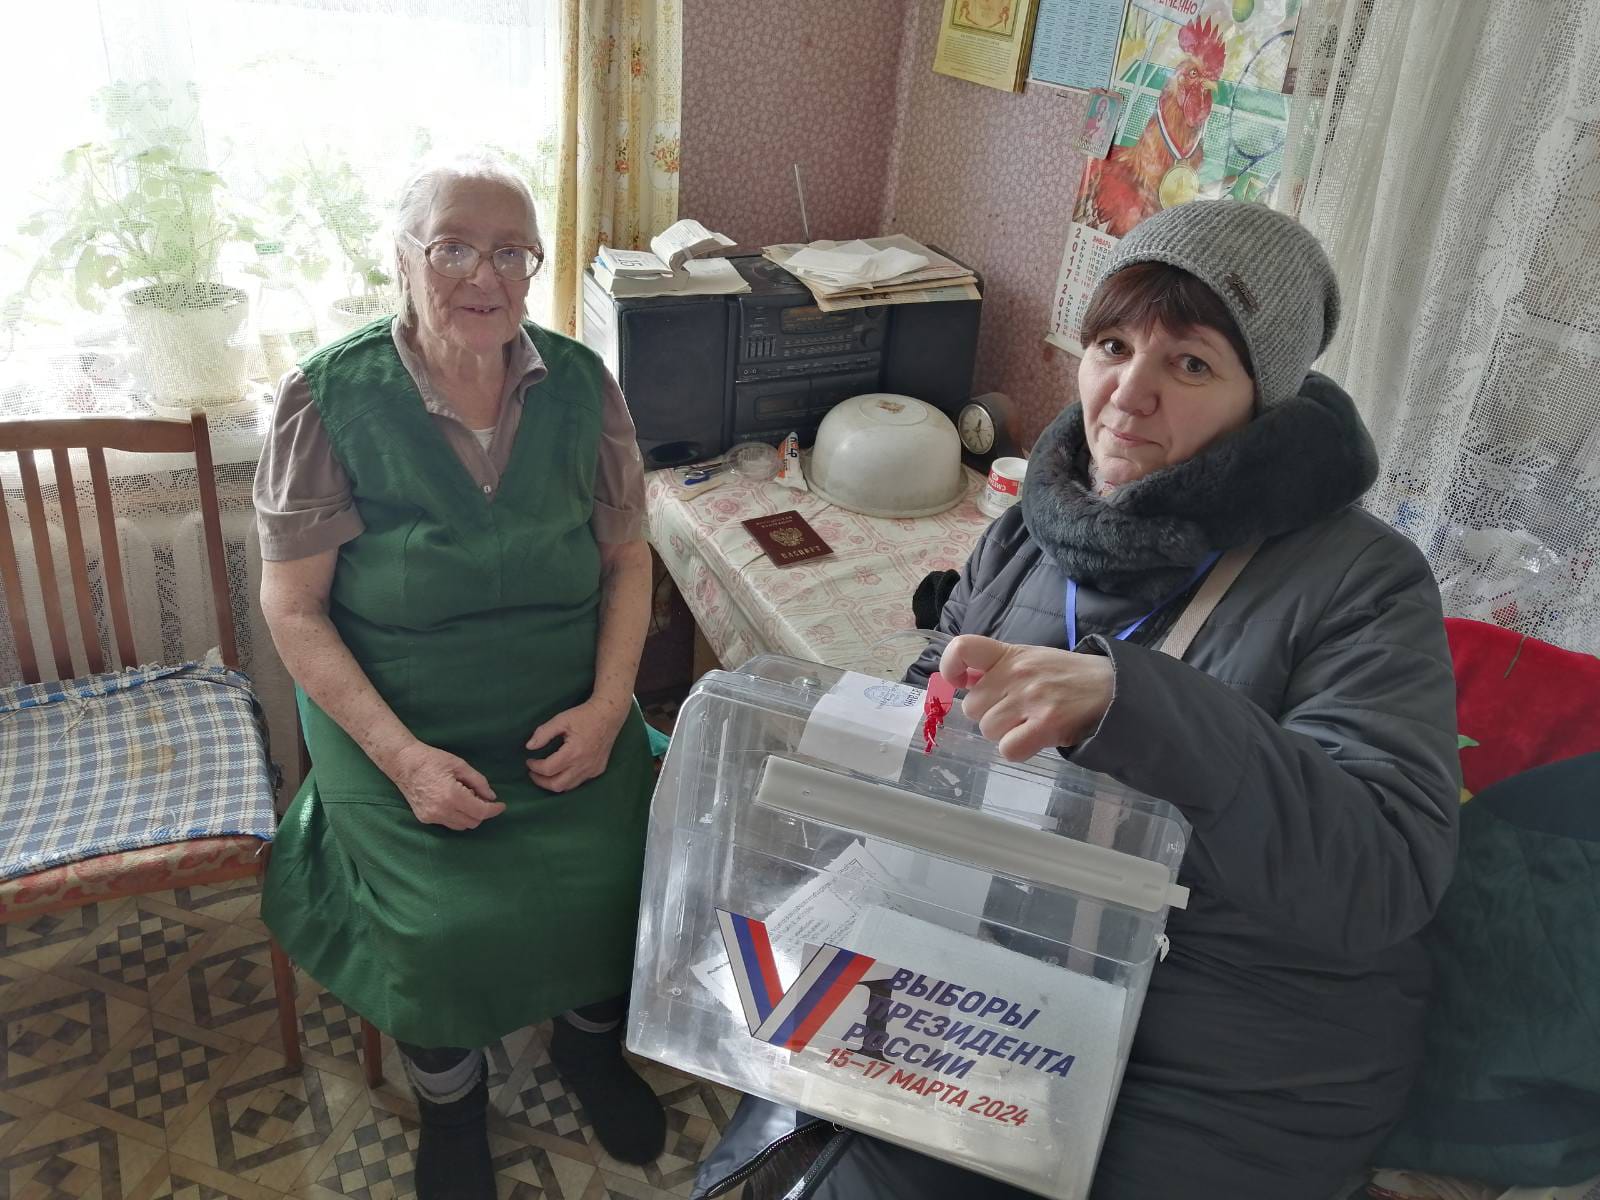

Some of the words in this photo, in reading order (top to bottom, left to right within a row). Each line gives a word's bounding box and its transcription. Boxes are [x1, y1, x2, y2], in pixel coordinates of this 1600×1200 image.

[890, 968, 1041, 1030] ВЫБОРЫ
[841, 1022, 977, 1080] РОССИИ
[863, 1000, 1077, 1078] ПРЕЗИДЕНТА
[887, 1068, 969, 1108] МАРТА
[968, 1095, 1030, 1127] 2024
